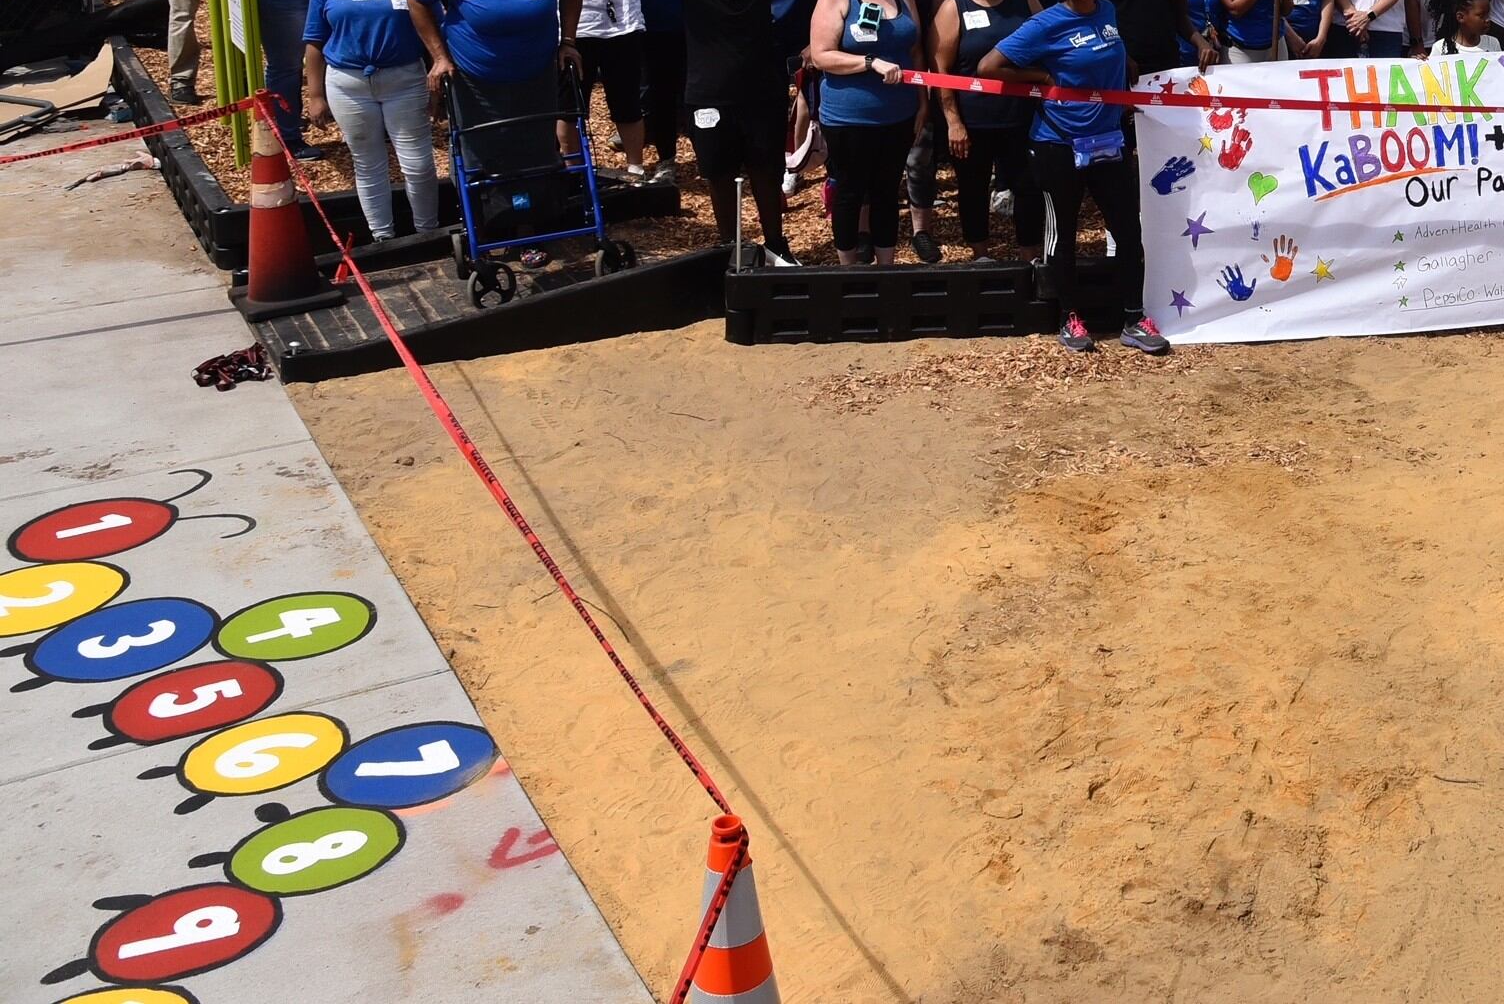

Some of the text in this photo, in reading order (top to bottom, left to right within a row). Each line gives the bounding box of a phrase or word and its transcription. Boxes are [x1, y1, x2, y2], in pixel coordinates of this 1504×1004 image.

[1299, 58, 1494, 132] THANK
[1298, 123, 1480, 198] KaBOOM!
[1404, 173, 1459, 208] Our
[1414, 220, 1497, 240] AdventHealth
[1416, 249, 1494, 273] Gallagher
[55, 513, 133, 540] 1
[76, 619, 177, 660] 3
[246, 607, 342, 644] 4
[148, 678, 244, 719] 5
[213, 732, 318, 779] 6
[354, 739, 460, 778] 7
[261, 829, 368, 876] 8
[117, 905, 241, 960] 9
